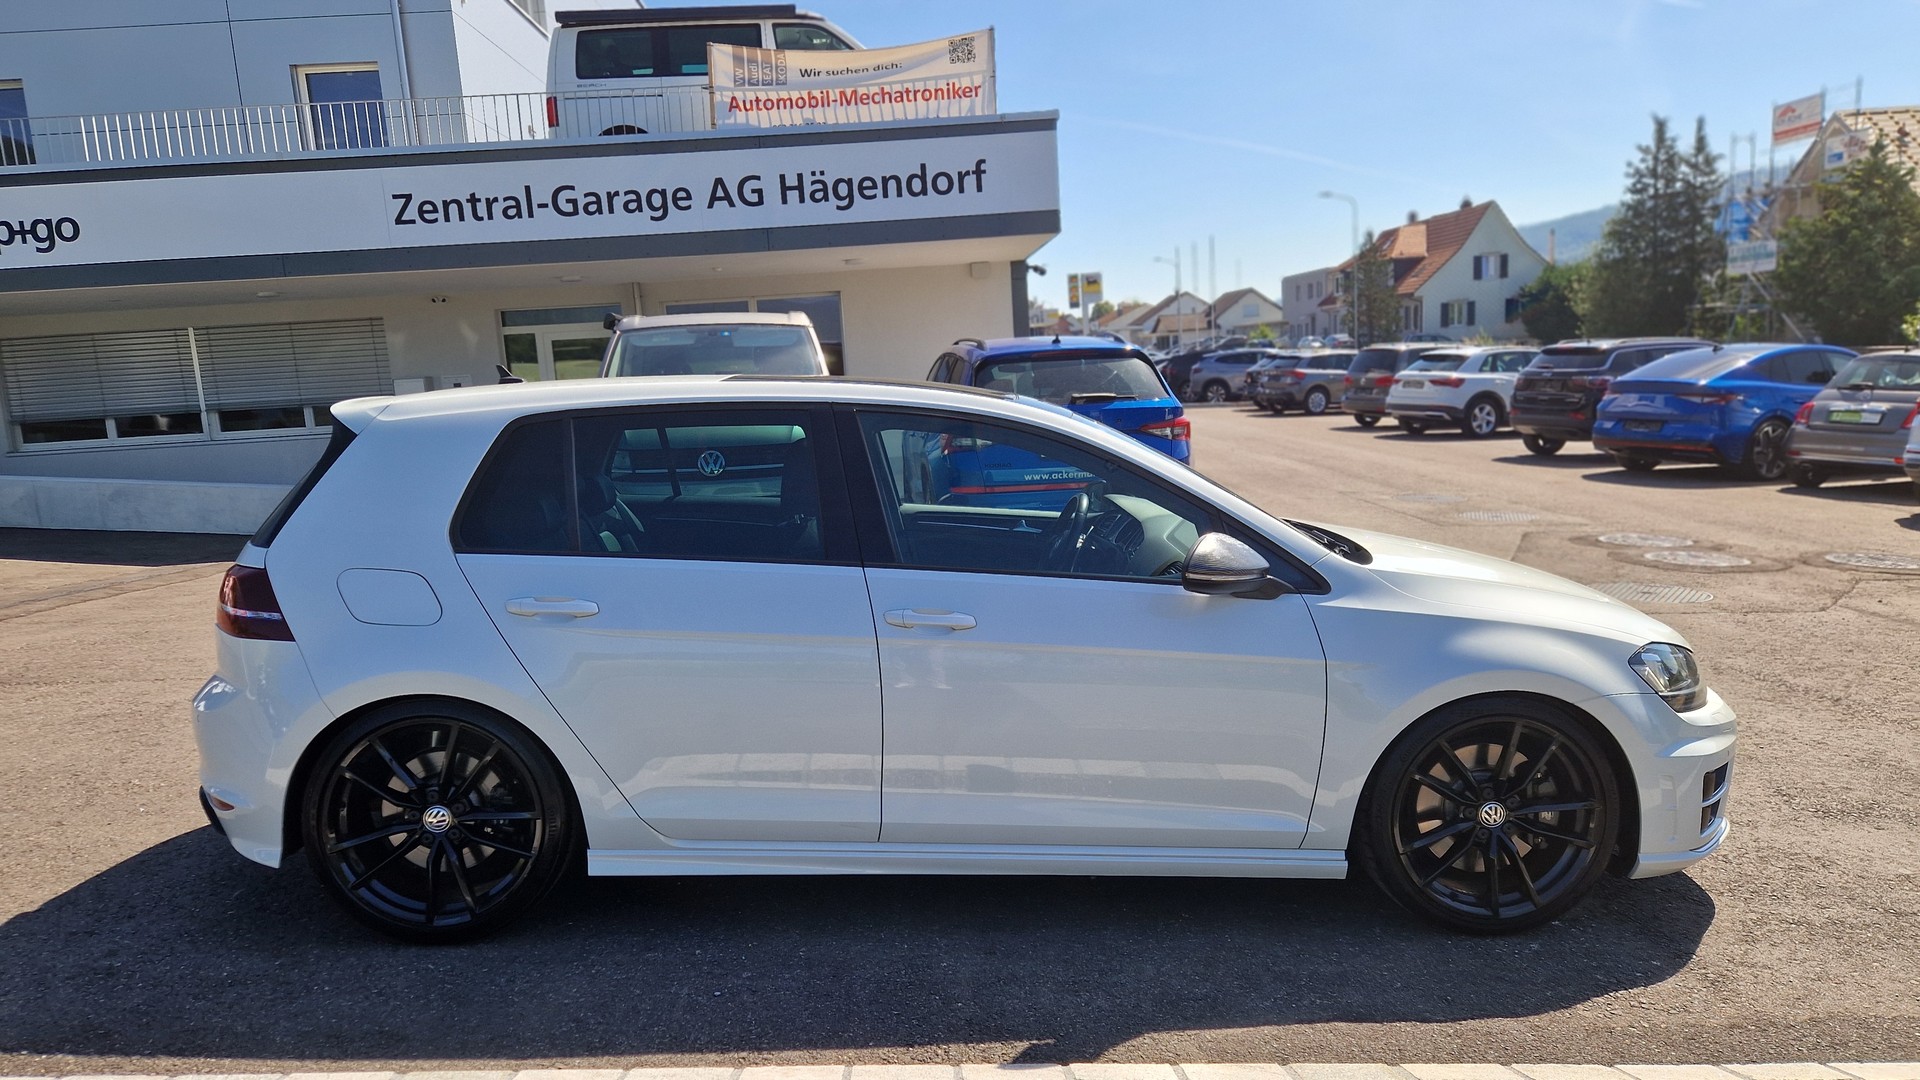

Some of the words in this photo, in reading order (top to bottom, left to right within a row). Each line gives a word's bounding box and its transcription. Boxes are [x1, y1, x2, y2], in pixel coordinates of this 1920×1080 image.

[735, 68, 744, 85] VW
[749, 63, 759, 84] Audi
[763, 62, 772, 84] SEAT
[800, 68, 821, 78] Wir
[825, 67, 869, 76] suchen
[873, 63, 903, 72] dich:
[728, 82, 982, 113] Automobil-Mechatroniker
[392, 184, 693, 222] Zentral-Garage
[707, 175, 765, 209] AG
[779, 159, 987, 211] Hägendorf
